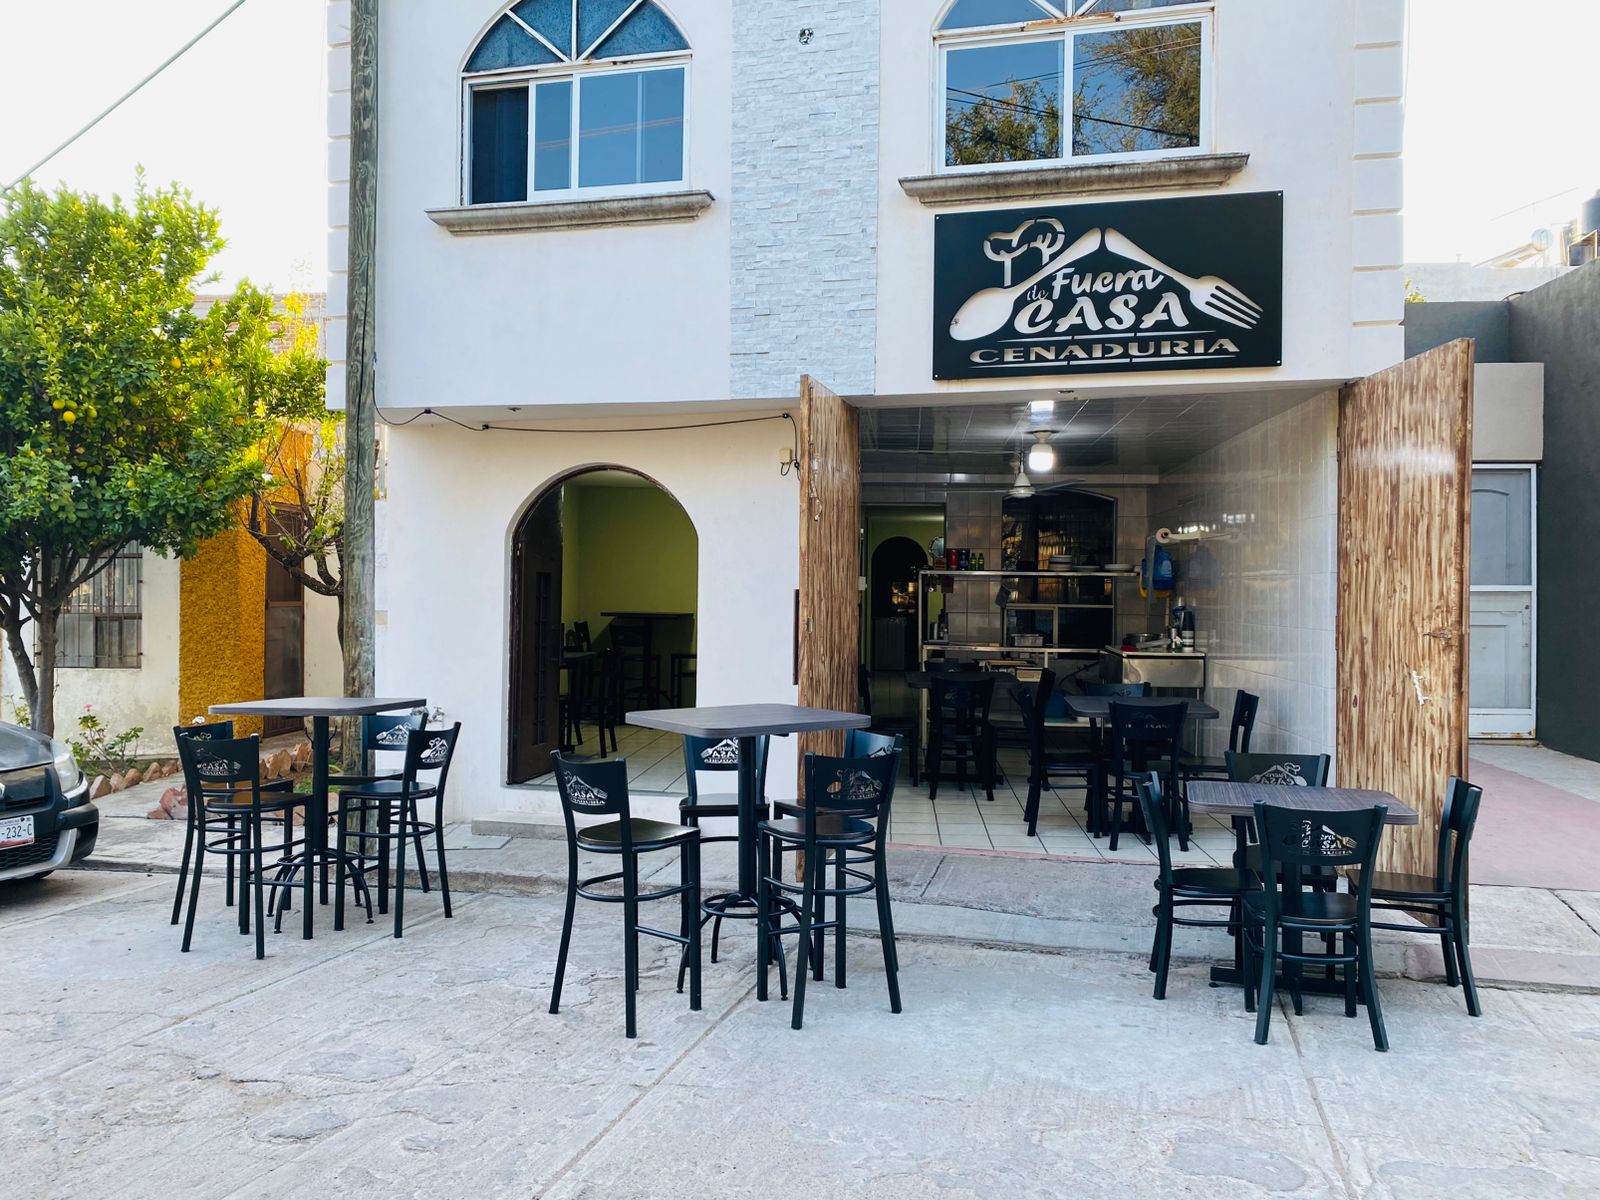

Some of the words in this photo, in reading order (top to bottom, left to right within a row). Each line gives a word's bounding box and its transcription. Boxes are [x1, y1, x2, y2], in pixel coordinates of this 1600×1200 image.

[1026, 283, 1049, 301] de
[1052, 267, 1165, 300] Fuera
[1013, 292, 1190, 334] CASA
[968, 338, 1241, 364] CENADURIA
